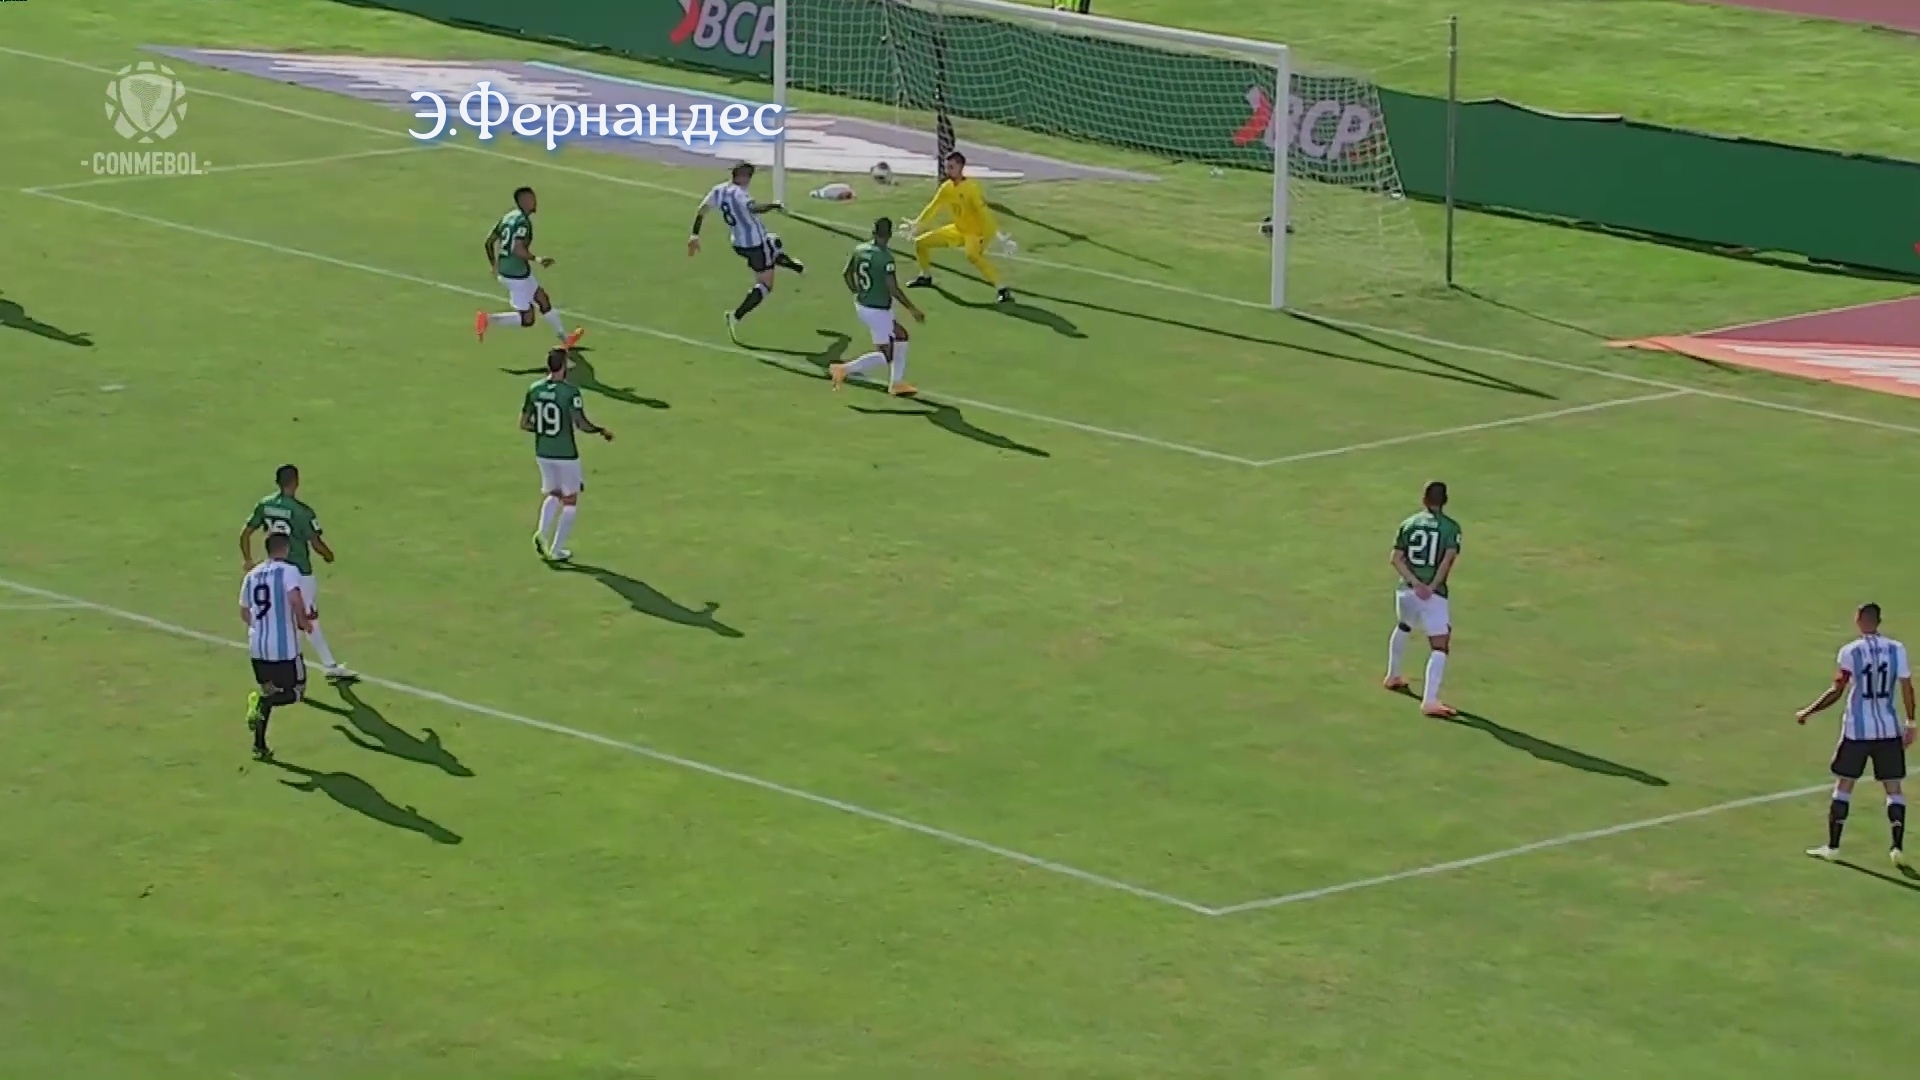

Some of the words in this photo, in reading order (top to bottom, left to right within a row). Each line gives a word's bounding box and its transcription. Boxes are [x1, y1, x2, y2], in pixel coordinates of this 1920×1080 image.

[721, 201, 737, 226] 8
[533, 401, 561, 436] 19
[1407, 529, 1440, 567] 21
[253, 583, 272, 620] 9
[1861, 661, 1890, 699] 11
